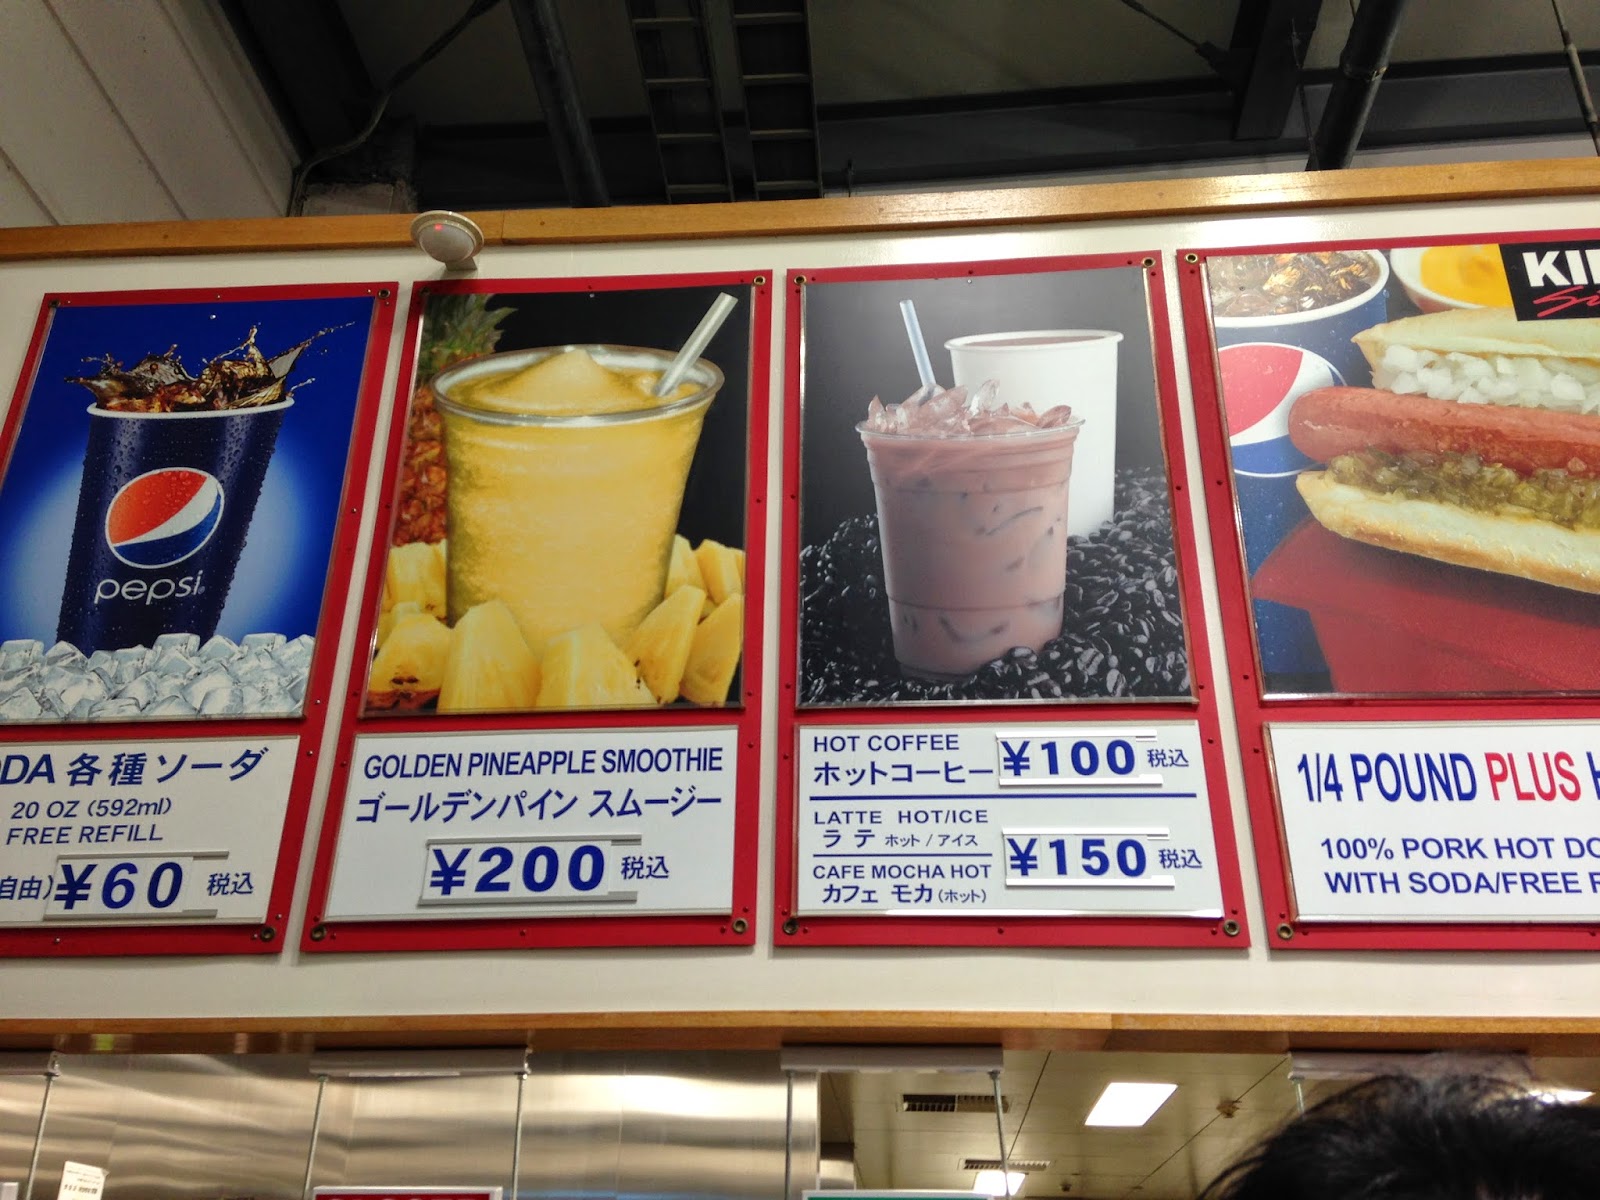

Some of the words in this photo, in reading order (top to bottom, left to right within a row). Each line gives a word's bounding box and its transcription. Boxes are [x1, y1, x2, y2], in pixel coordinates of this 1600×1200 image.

[94, 570, 203, 605] pepsi
[813, 735, 861, 753] HOT
[867, 734, 960, 752] COFFEE
[1001, 739, 1135, 777] ¥100
[1147, 749, 1189, 768] 税込
[0, 753, 56, 785] DA
[363, 752, 463, 780] GOLDEN
[467, 749, 597, 777] PINEAPPLE
[601, 747, 723, 774] SMOOTHIE
[813, 760, 994, 787] ホットコーヒー
[1297, 753, 1344, 803] 1/4
[1349, 752, 1477, 802] POUND
[1484, 751, 1582, 802] PLUS
[11, 801, 40, 820] 20
[46, 799, 80, 819] OZ
[88, 798, 172, 817] (592ml)
[355, 788, 579, 823] ゴールデンパイン
[588, 784, 722, 818] スムージー
[814, 810, 882, 825] LATTE
[898, 809, 988, 824] HOT/ICE
[6, 826, 71, 845] FREE
[79, 824, 163, 844] REFILL
[1321, 837, 1394, 860] 100%
[1401, 837, 1488, 859] PORK
[1494, 837, 1555, 859] HOT
[429, 844, 605, 896] ¥200
[620, 855, 670, 880] 税込
[812, 865, 865, 880] CAFE
[871, 864, 945, 879] MOCHA
[950, 864, 991, 879] HOT
[1006, 838, 1147, 878] ¥150
[1158, 849, 1202, 869] 税込
[54, 861, 184, 910] ¥60
[207, 872, 254, 896] 税込
[822, 883, 879, 904] カフェ
[1324, 872, 1401, 894] WITH
[1408, 871, 1582, 894] SODA/FREE
